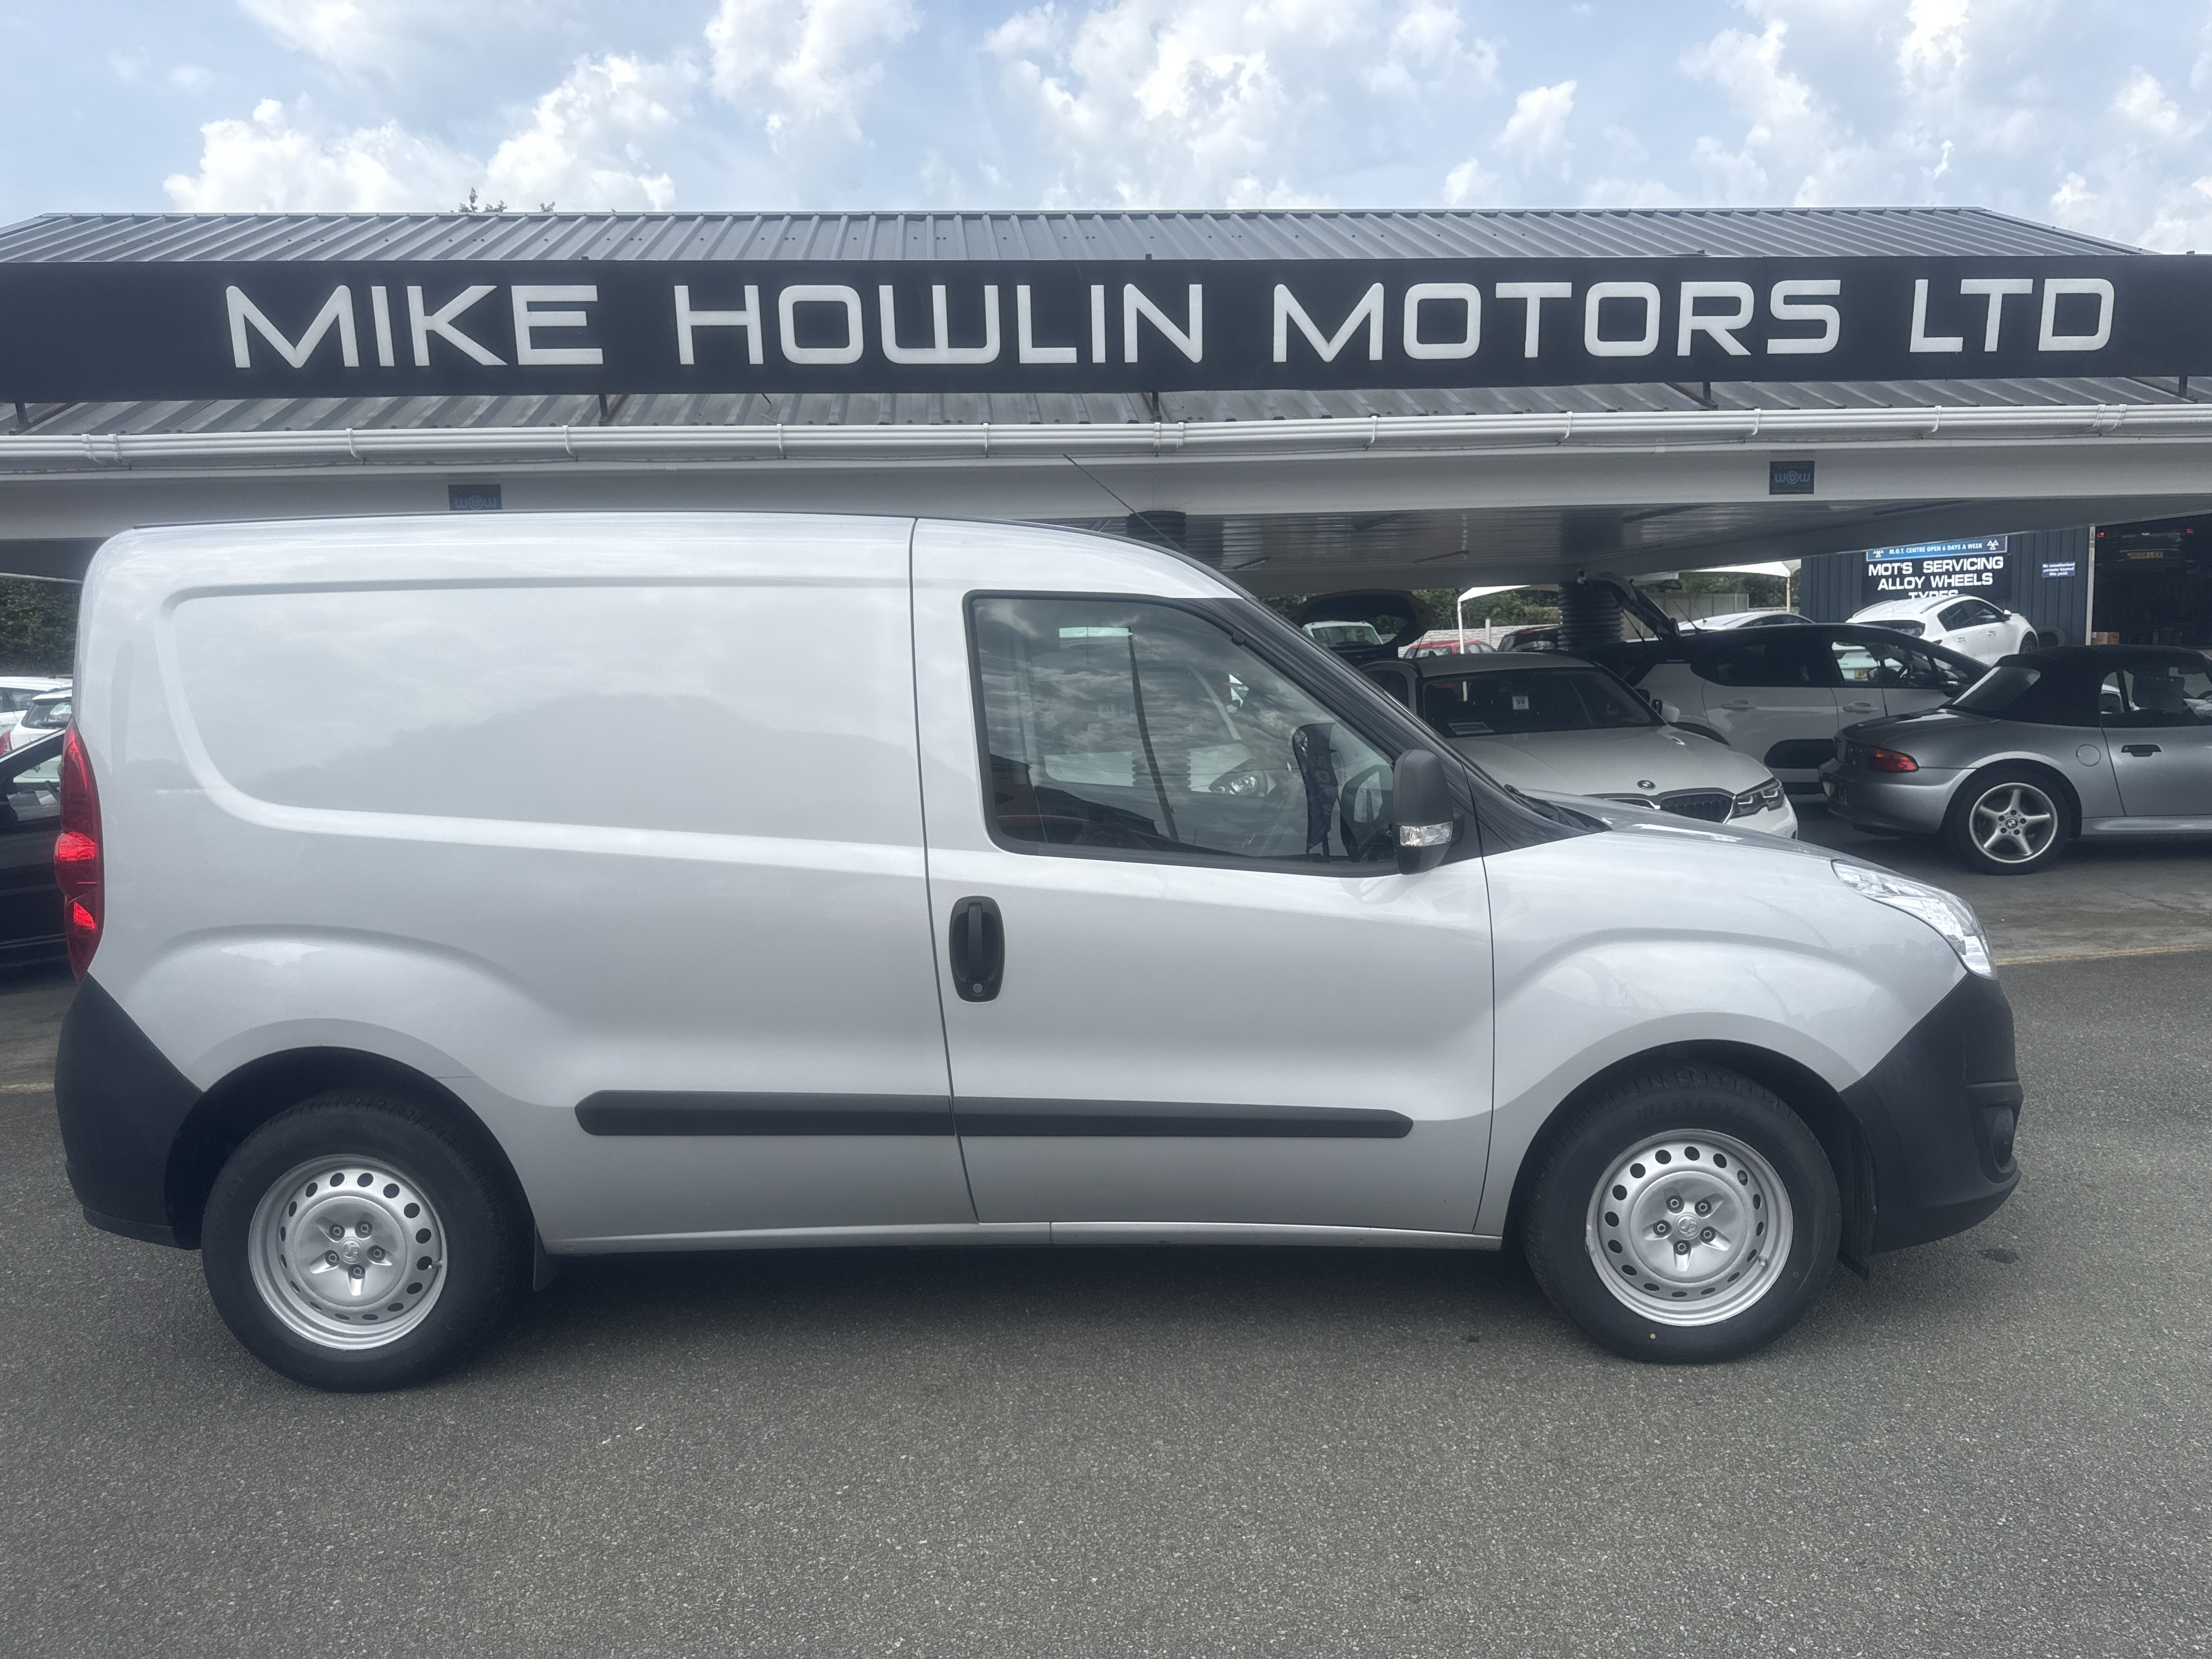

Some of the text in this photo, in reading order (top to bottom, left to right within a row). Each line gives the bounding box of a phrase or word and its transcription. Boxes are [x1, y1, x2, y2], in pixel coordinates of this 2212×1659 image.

[225, 278, 2114, 369] MIKE HOWLIN MOTORS LTD
[1868, 556, 2004, 577] MOT'S SERVICING
[1877, 572, 1993, 591] ALLOY WHEELS
